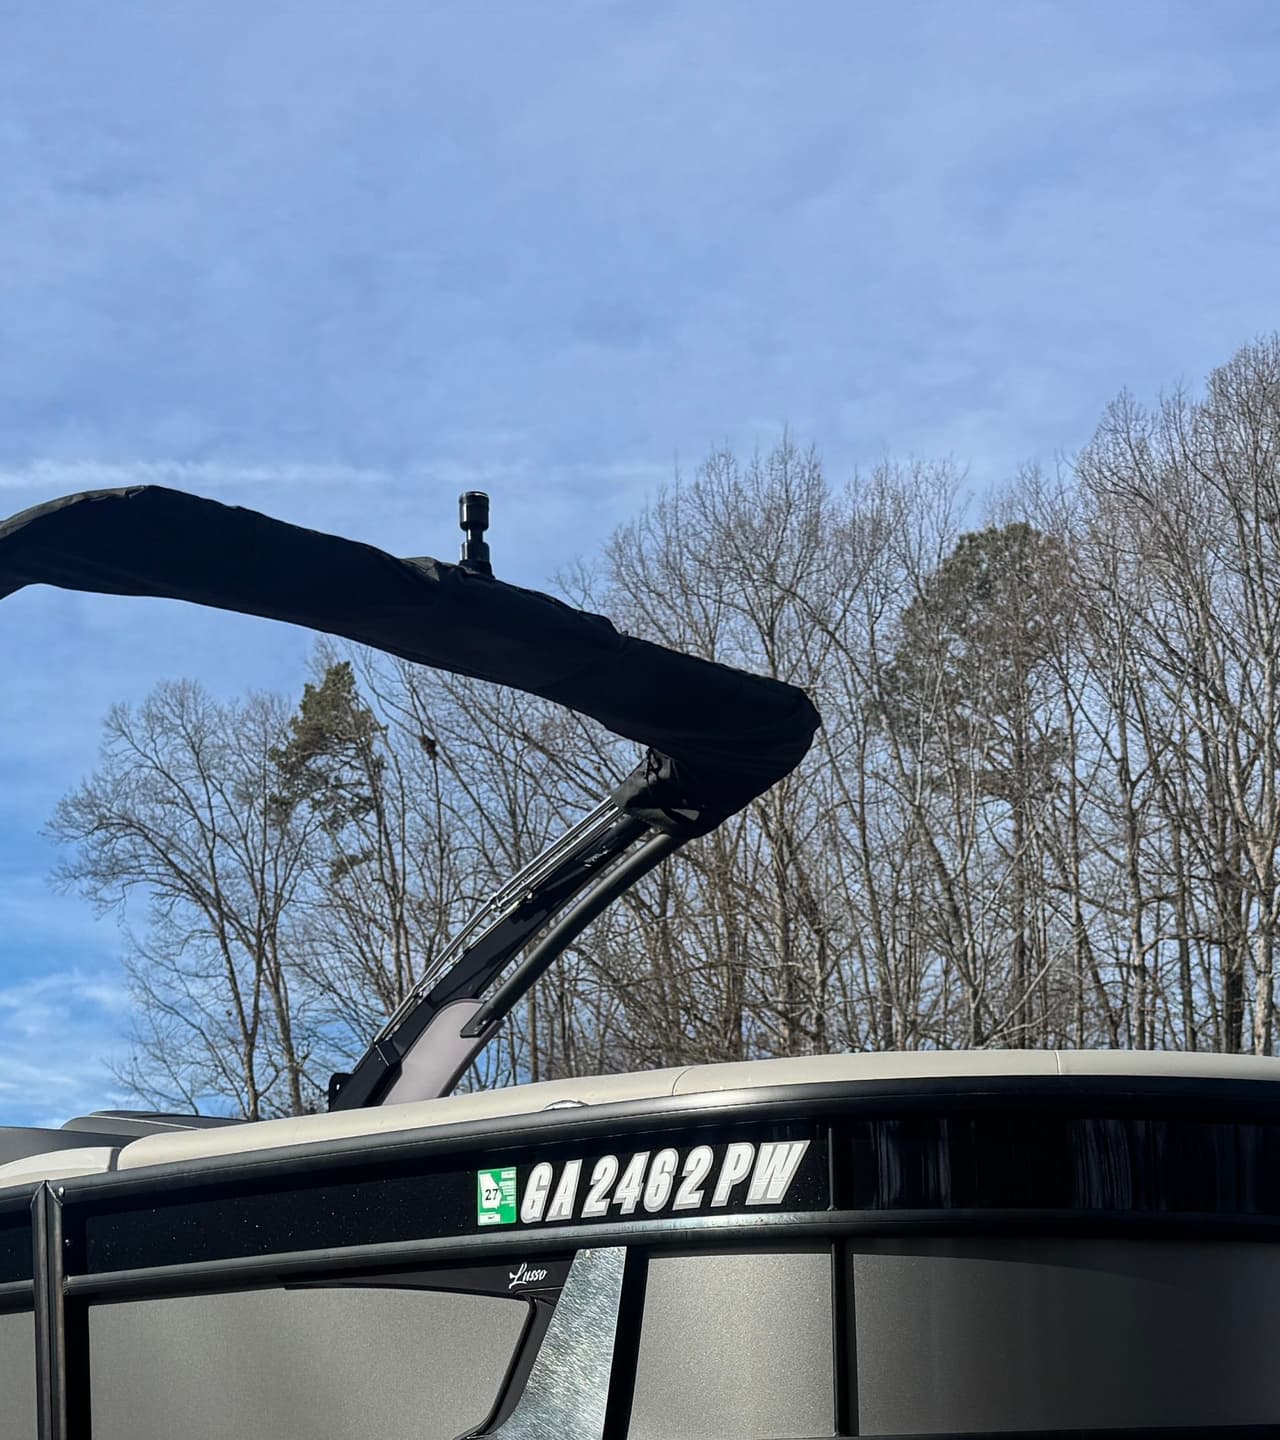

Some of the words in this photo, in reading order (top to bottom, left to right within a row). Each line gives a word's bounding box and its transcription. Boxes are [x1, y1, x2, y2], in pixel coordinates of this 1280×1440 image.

[485, 1188, 499, 1201] 27
[521, 1159, 583, 1224] GA
[580, 1144, 714, 1218] 2462
[710, 1139, 811, 1208] PW
[508, 1262, 548, 1289] Lusso
